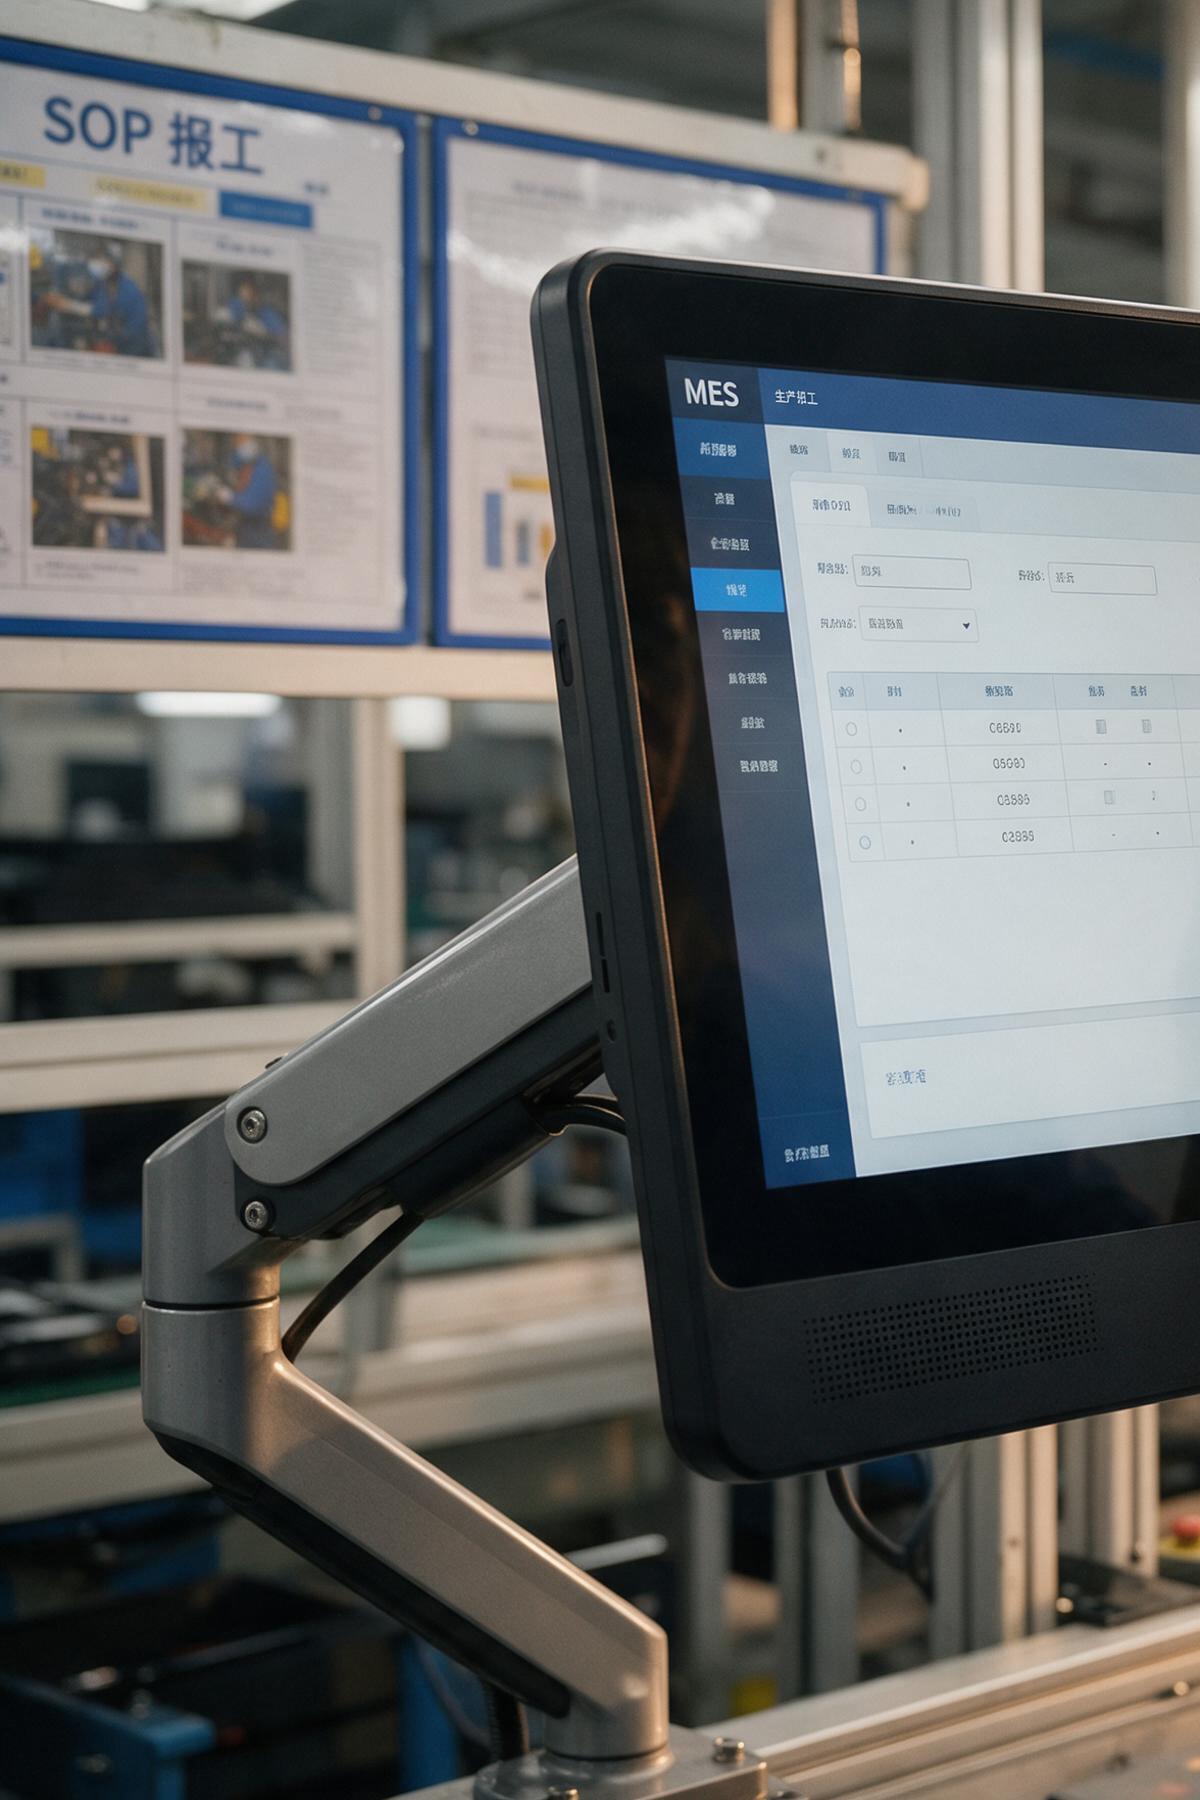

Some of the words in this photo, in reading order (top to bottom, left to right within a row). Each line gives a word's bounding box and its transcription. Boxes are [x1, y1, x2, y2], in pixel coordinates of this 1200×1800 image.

[43, 94, 153, 155] SOP
[168, 110, 265, 176] 报工
[684, 377, 740, 408] MES
